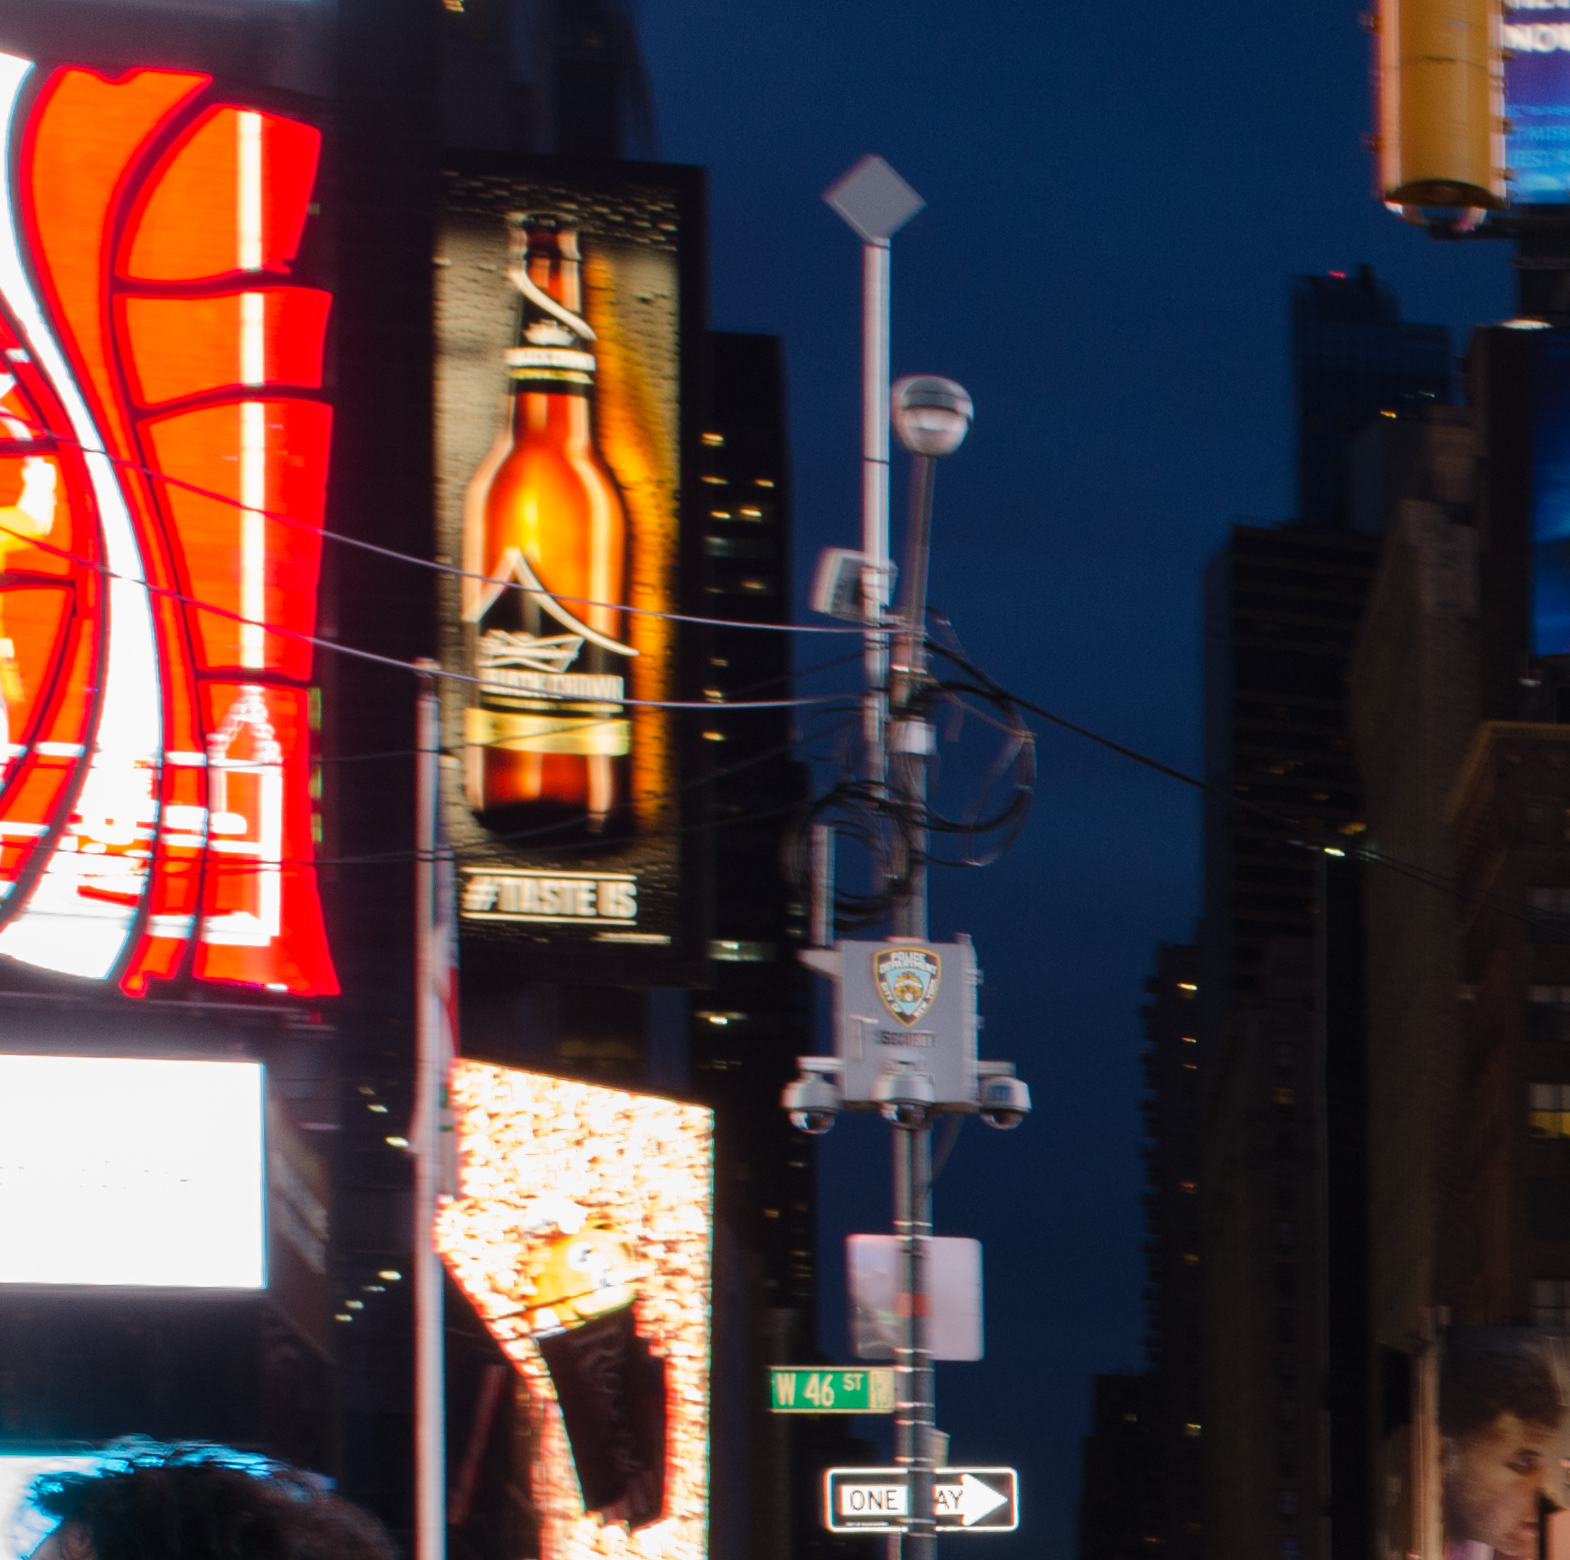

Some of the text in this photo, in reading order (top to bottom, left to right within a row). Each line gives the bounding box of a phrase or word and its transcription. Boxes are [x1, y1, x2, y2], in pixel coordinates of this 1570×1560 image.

[461, 876, 638, 919] #TASTE IS
[891, 951, 926, 962] POLICE
[879, 960, 938, 976] DEPARTMENT
[776, 1372, 864, 1407] W 46 ST
[850, 1489, 964, 1511] ONE AY
